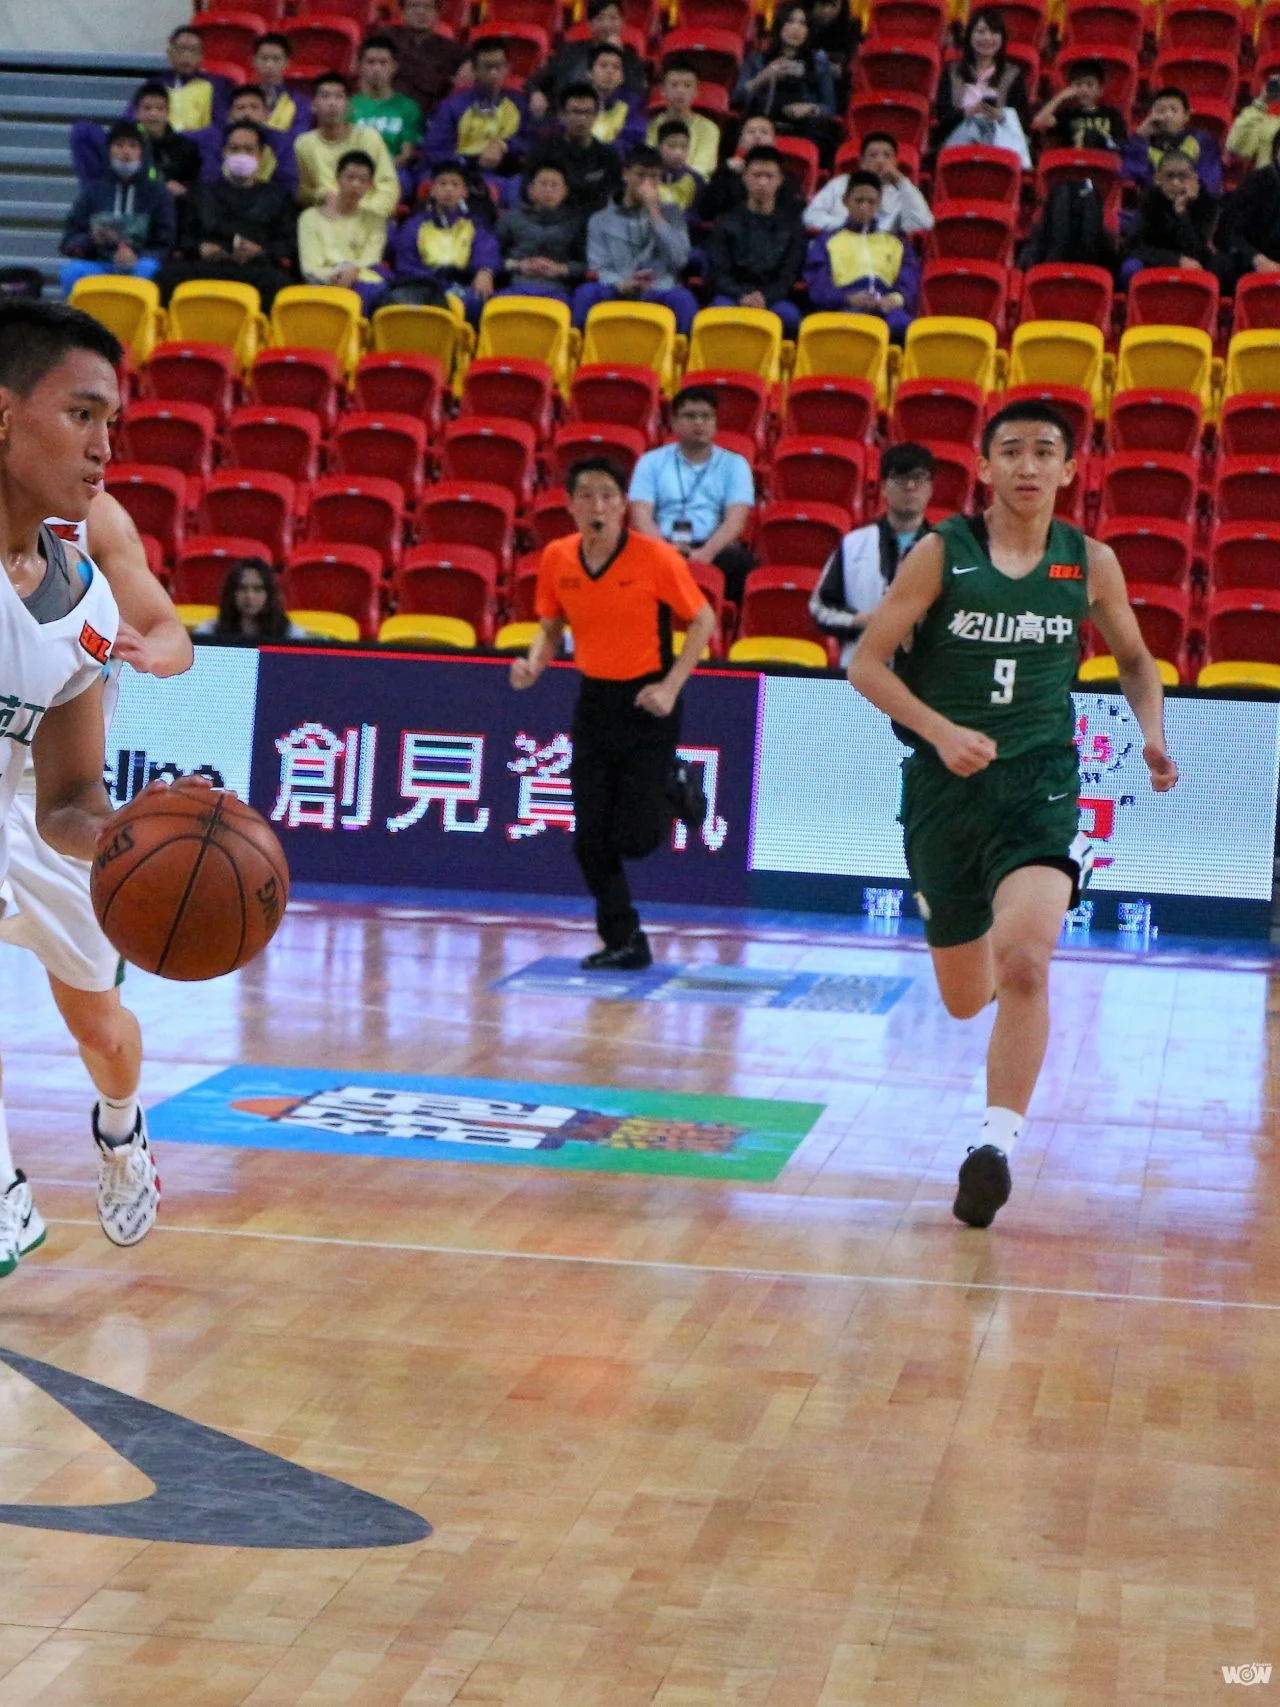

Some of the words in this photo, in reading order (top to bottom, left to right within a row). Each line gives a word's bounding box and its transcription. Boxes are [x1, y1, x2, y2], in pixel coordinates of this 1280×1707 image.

[948, 609, 1073, 644] 松山高中
[990, 658, 1016, 704] 9
